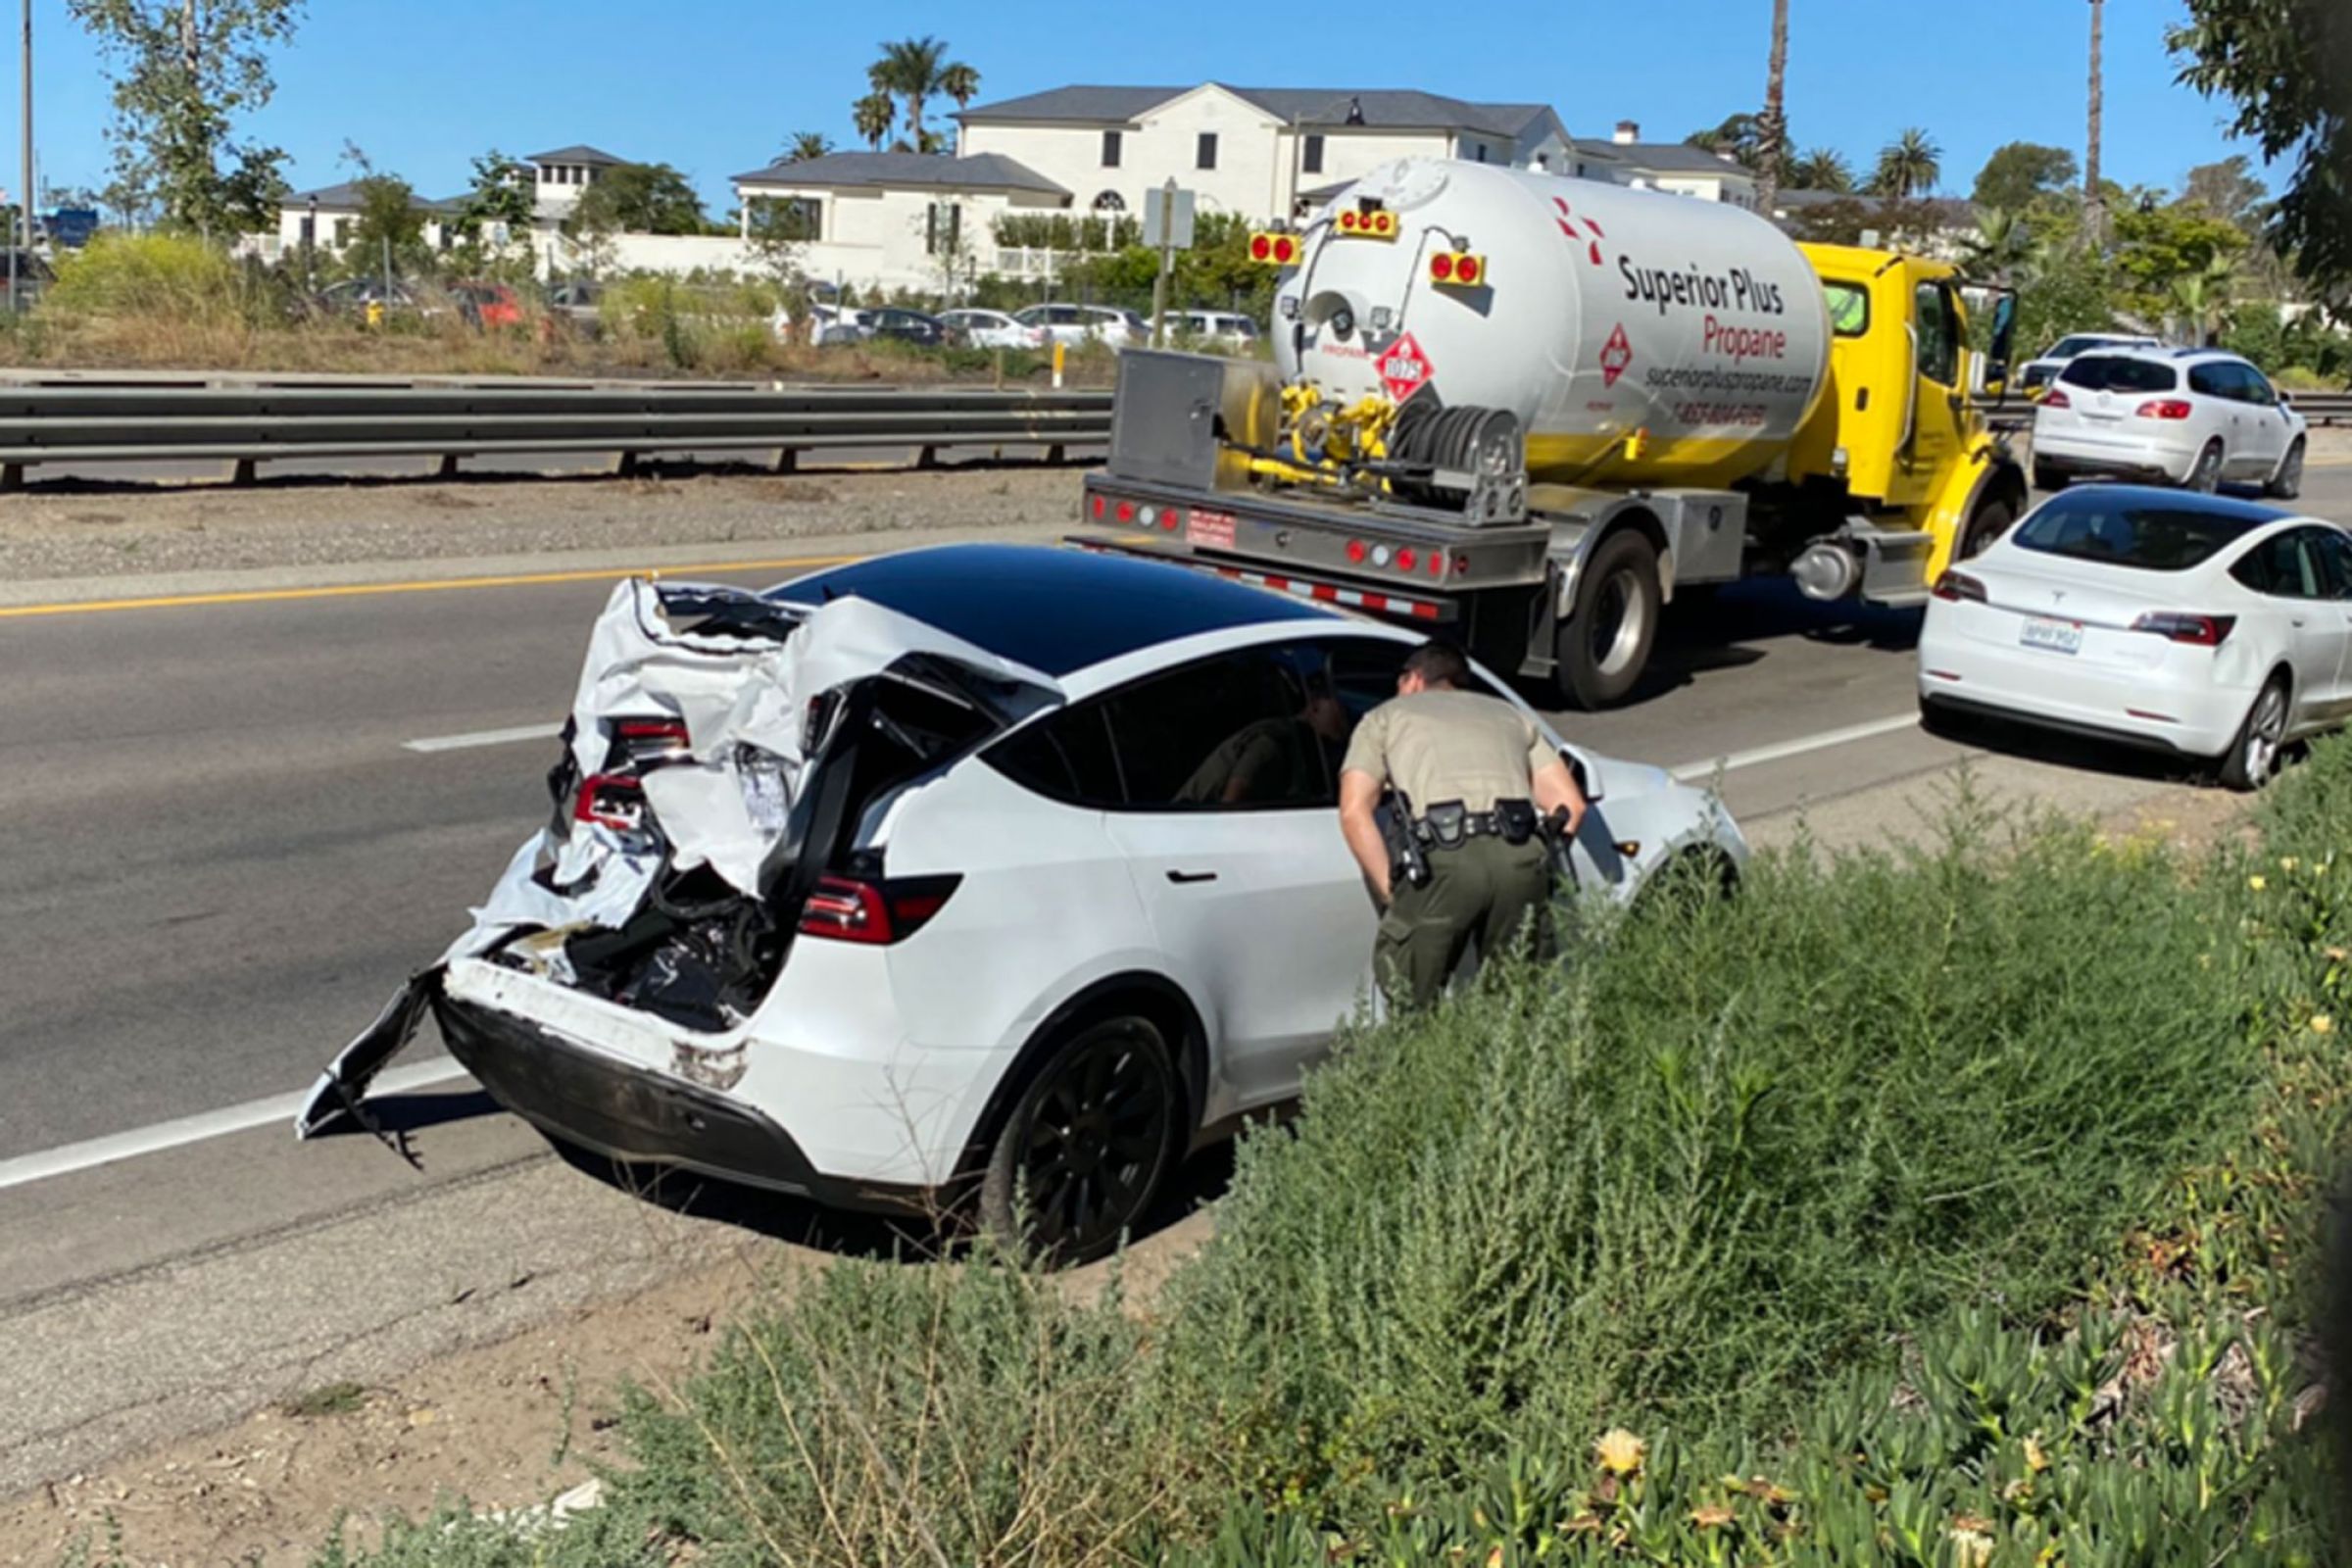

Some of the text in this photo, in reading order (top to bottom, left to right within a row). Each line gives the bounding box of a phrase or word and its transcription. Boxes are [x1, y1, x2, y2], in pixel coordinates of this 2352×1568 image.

[1618, 254, 1784, 317] Superior Plus
[1702, 315, 1787, 366] Propane
